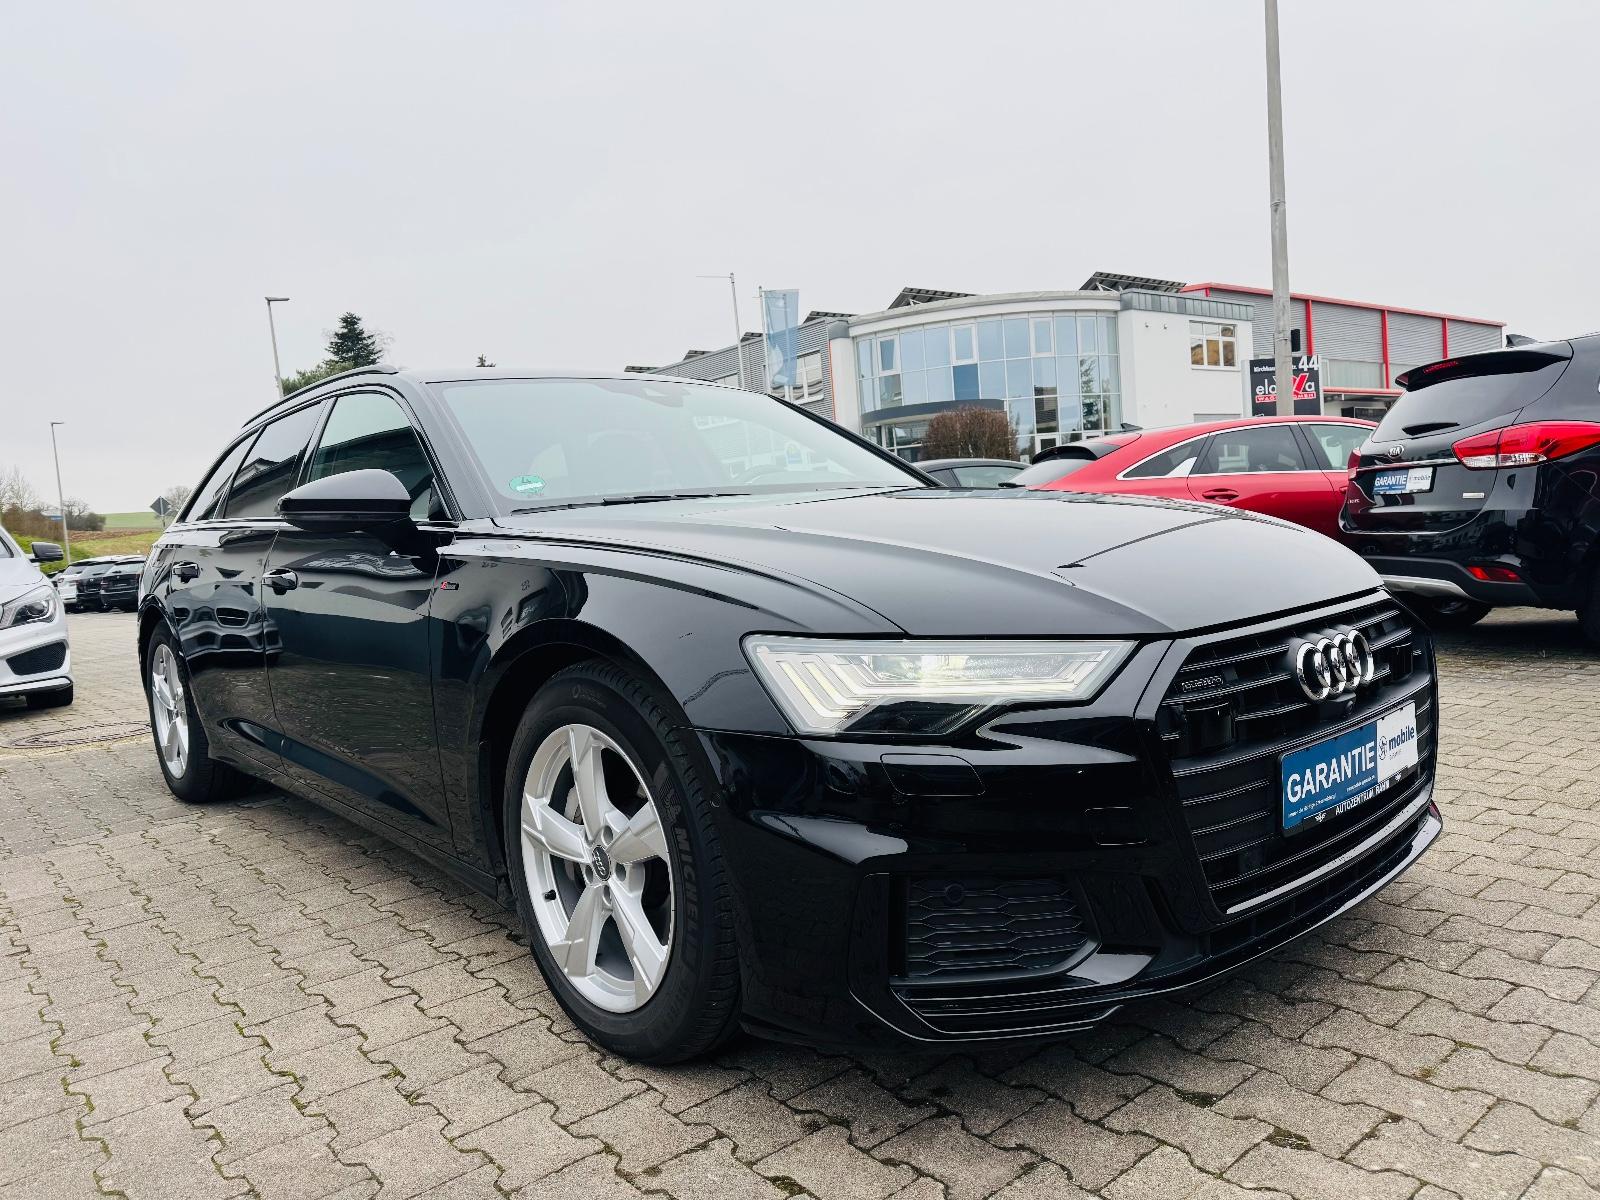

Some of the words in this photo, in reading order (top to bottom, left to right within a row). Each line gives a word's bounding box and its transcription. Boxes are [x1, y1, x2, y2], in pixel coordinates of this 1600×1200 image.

[1299, 355, 1319, 371] 44
[1375, 474, 1408, 487] GARANTIE
[1389, 725, 1415, 751] mobile
[1286, 741, 1375, 803] GARANTIE
[1335, 788, 1375, 816] AUTOZENTRUM
